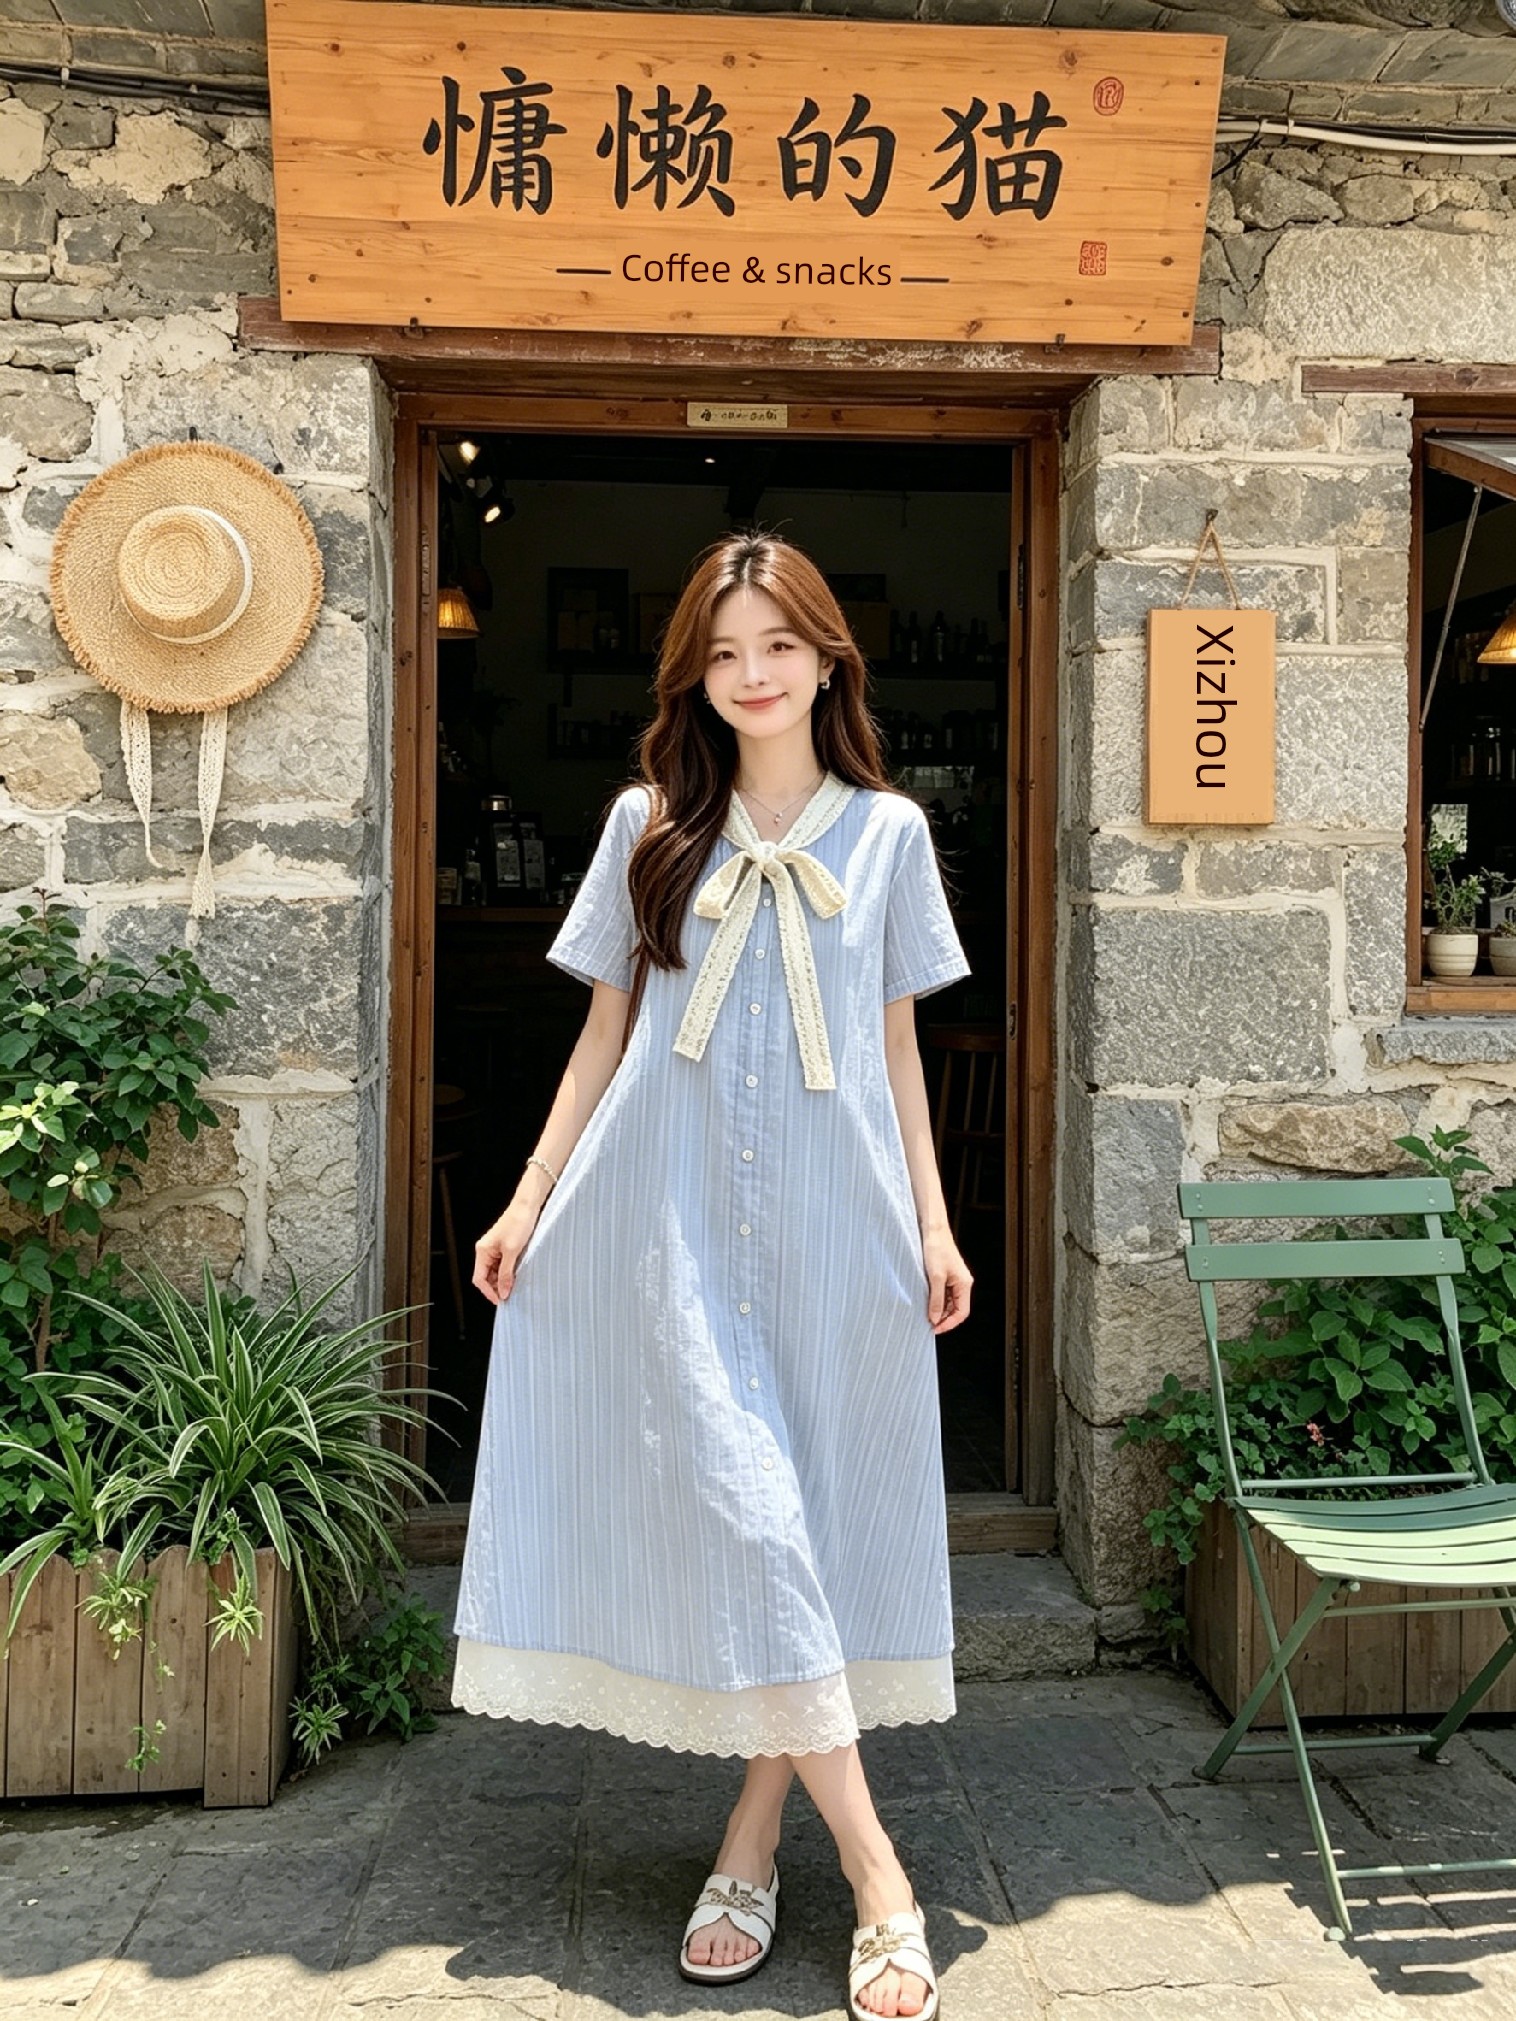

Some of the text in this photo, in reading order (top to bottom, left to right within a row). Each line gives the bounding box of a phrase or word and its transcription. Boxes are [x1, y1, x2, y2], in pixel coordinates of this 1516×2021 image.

[422, 66, 1068, 221] 慵懒的猫
[622, 253, 892, 286] Coffee & snacks
[1195, 624, 1238, 788] Xizhou
